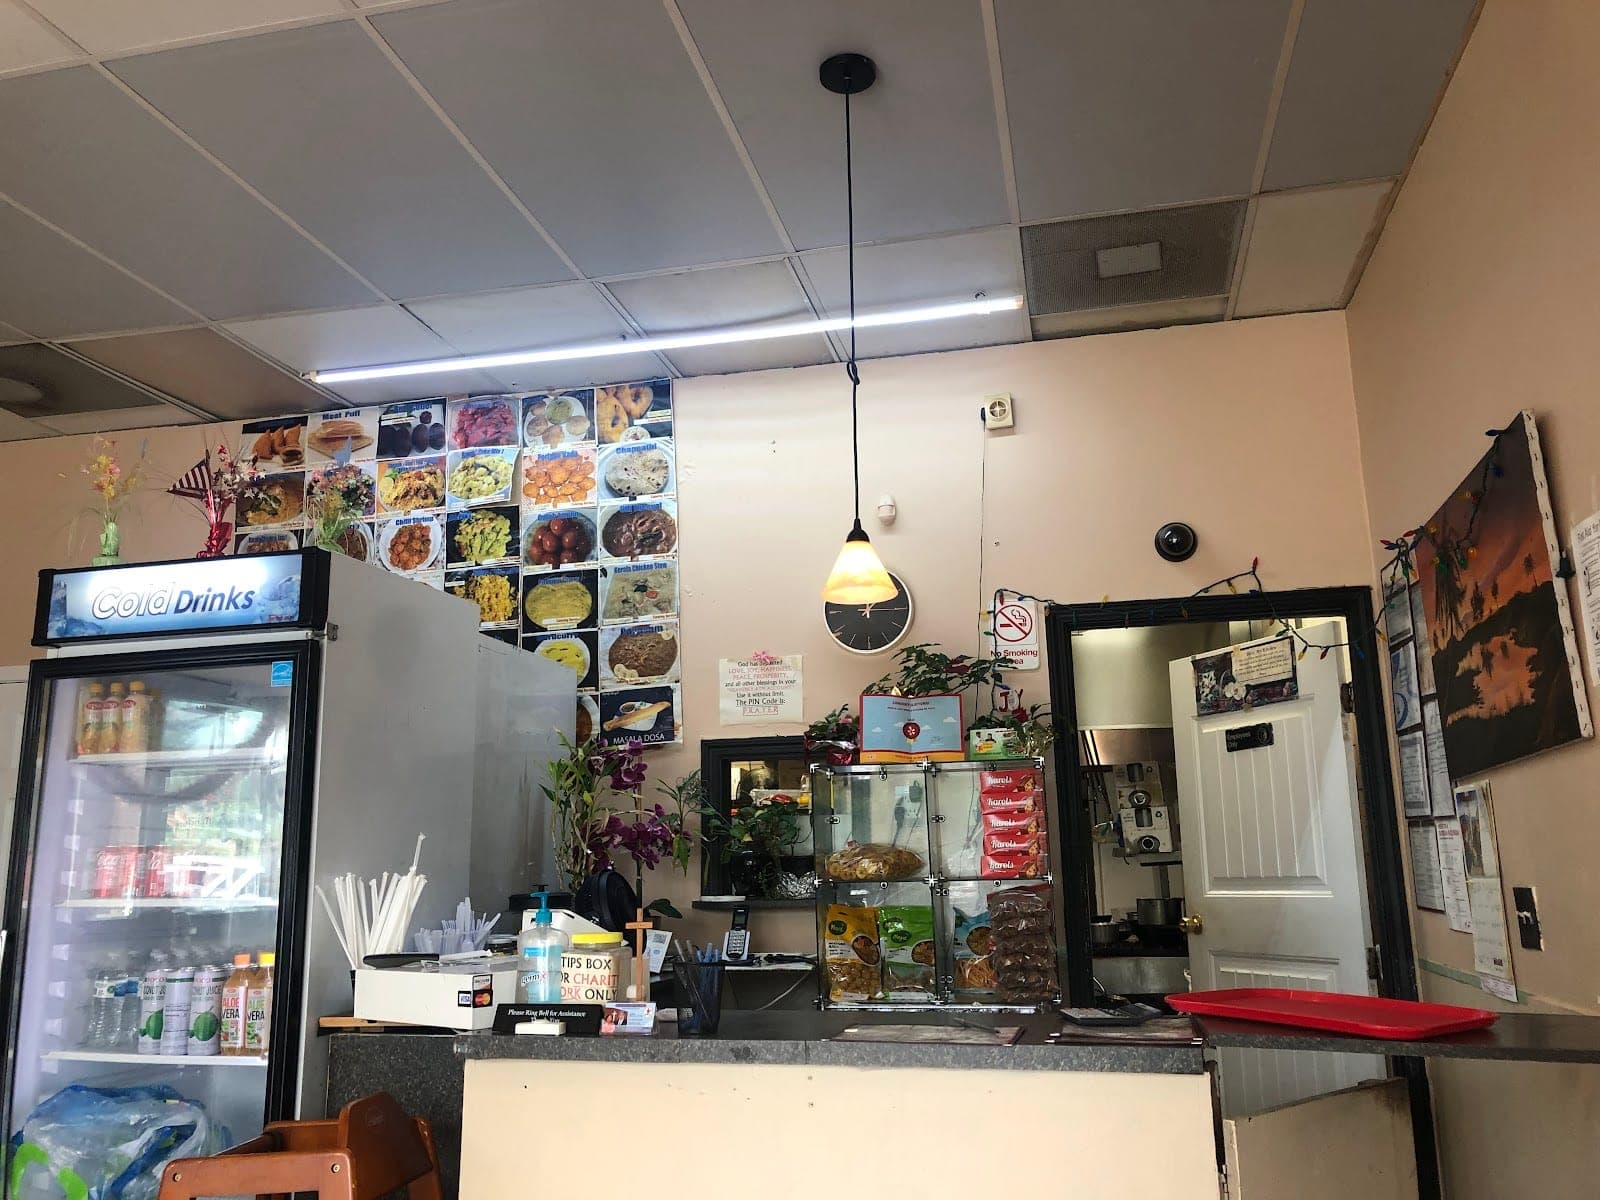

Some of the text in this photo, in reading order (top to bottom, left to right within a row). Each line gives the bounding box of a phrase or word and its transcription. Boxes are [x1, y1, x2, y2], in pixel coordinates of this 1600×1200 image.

[322, 410, 342, 420] Meat
[632, 563, 654, 571] Chicken
[92, 581, 256, 620] Cold Drinks
[1003, 649, 1038, 658] Smoking
[735, 699, 747, 707] The
[761, 697, 778, 705] Code
[613, 733, 665, 745] MASALA DOSA
[561, 956, 612, 970] TIPS BOX
[560, 986, 618, 1001] ORK ONLY
[222, 996, 240, 1007] ALOE
[222, 1008, 240, 1019] VERA
[247, 1010, 265, 1022] VERA
[507, 1009, 524, 1017] Please
[524, 1009, 538, 1018] Ring
[538, 1009, 549, 1017] Bell
